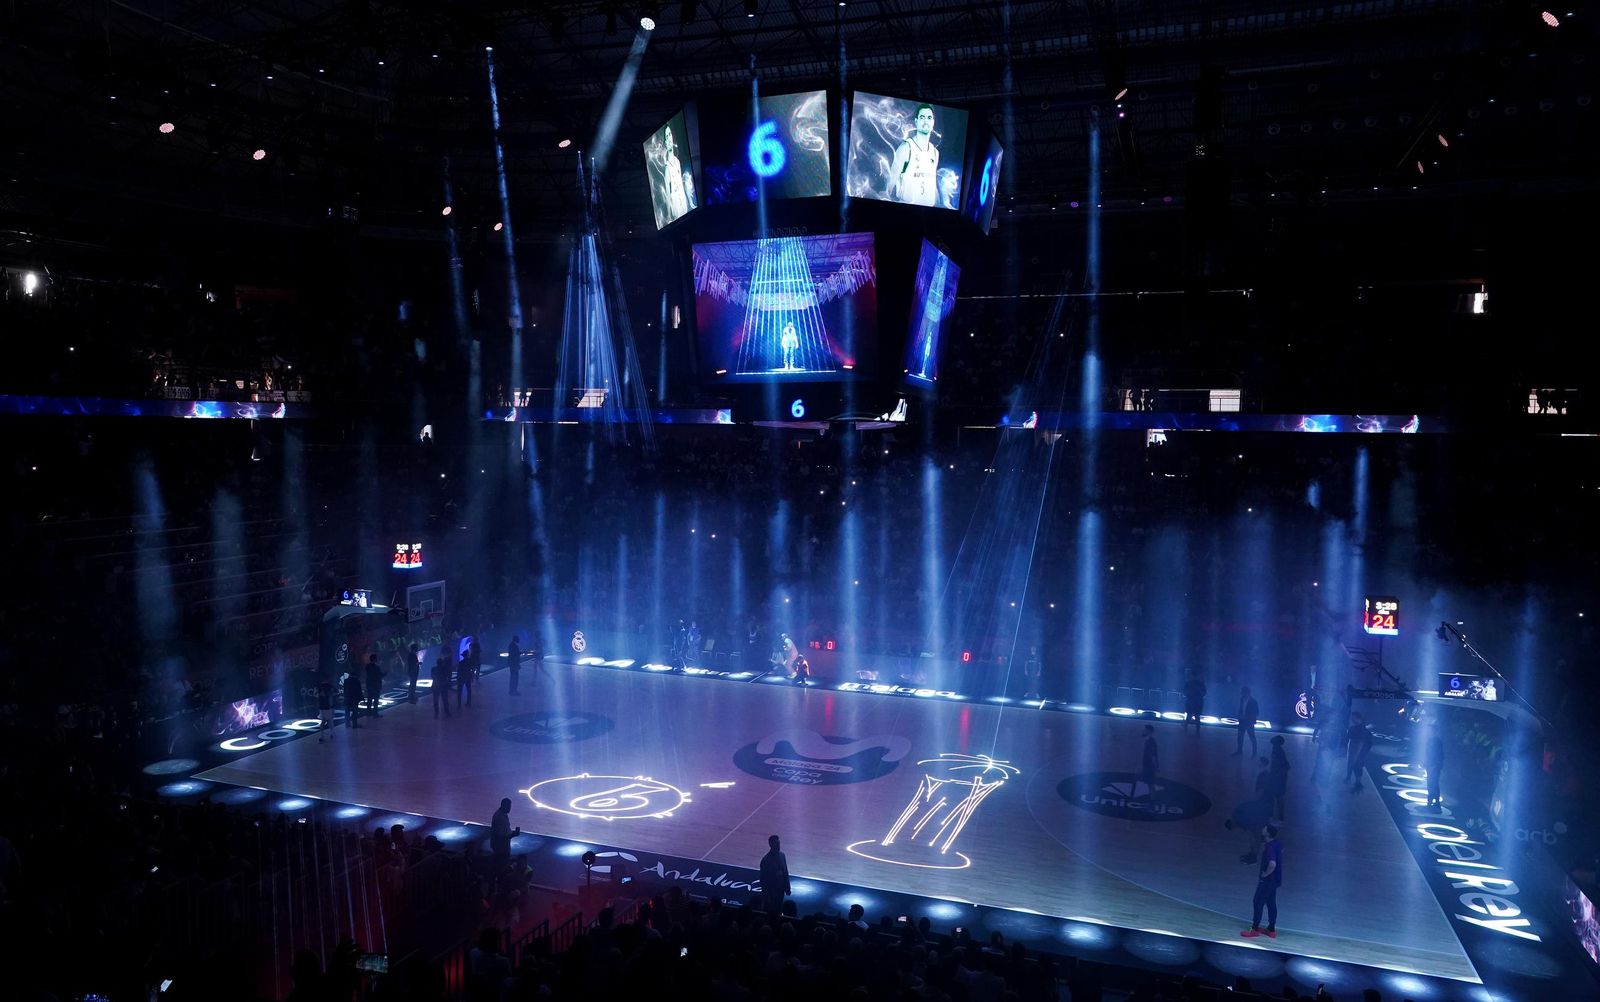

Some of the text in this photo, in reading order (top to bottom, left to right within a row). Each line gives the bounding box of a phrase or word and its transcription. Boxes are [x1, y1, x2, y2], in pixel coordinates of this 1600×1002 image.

[748, 121, 786, 176] 6
[980, 158, 992, 206] 6
[791, 400, 805, 418] 6
[395, 553, 407, 564] 24
[411, 553, 420, 564] 24
[343, 591, 349, 599] 6
[1372, 615, 1395, 629] 24
[963, 652, 969, 662] 0
[1450, 677, 1460, 689] 6
[1444, 871, 1542, 943] Rey
